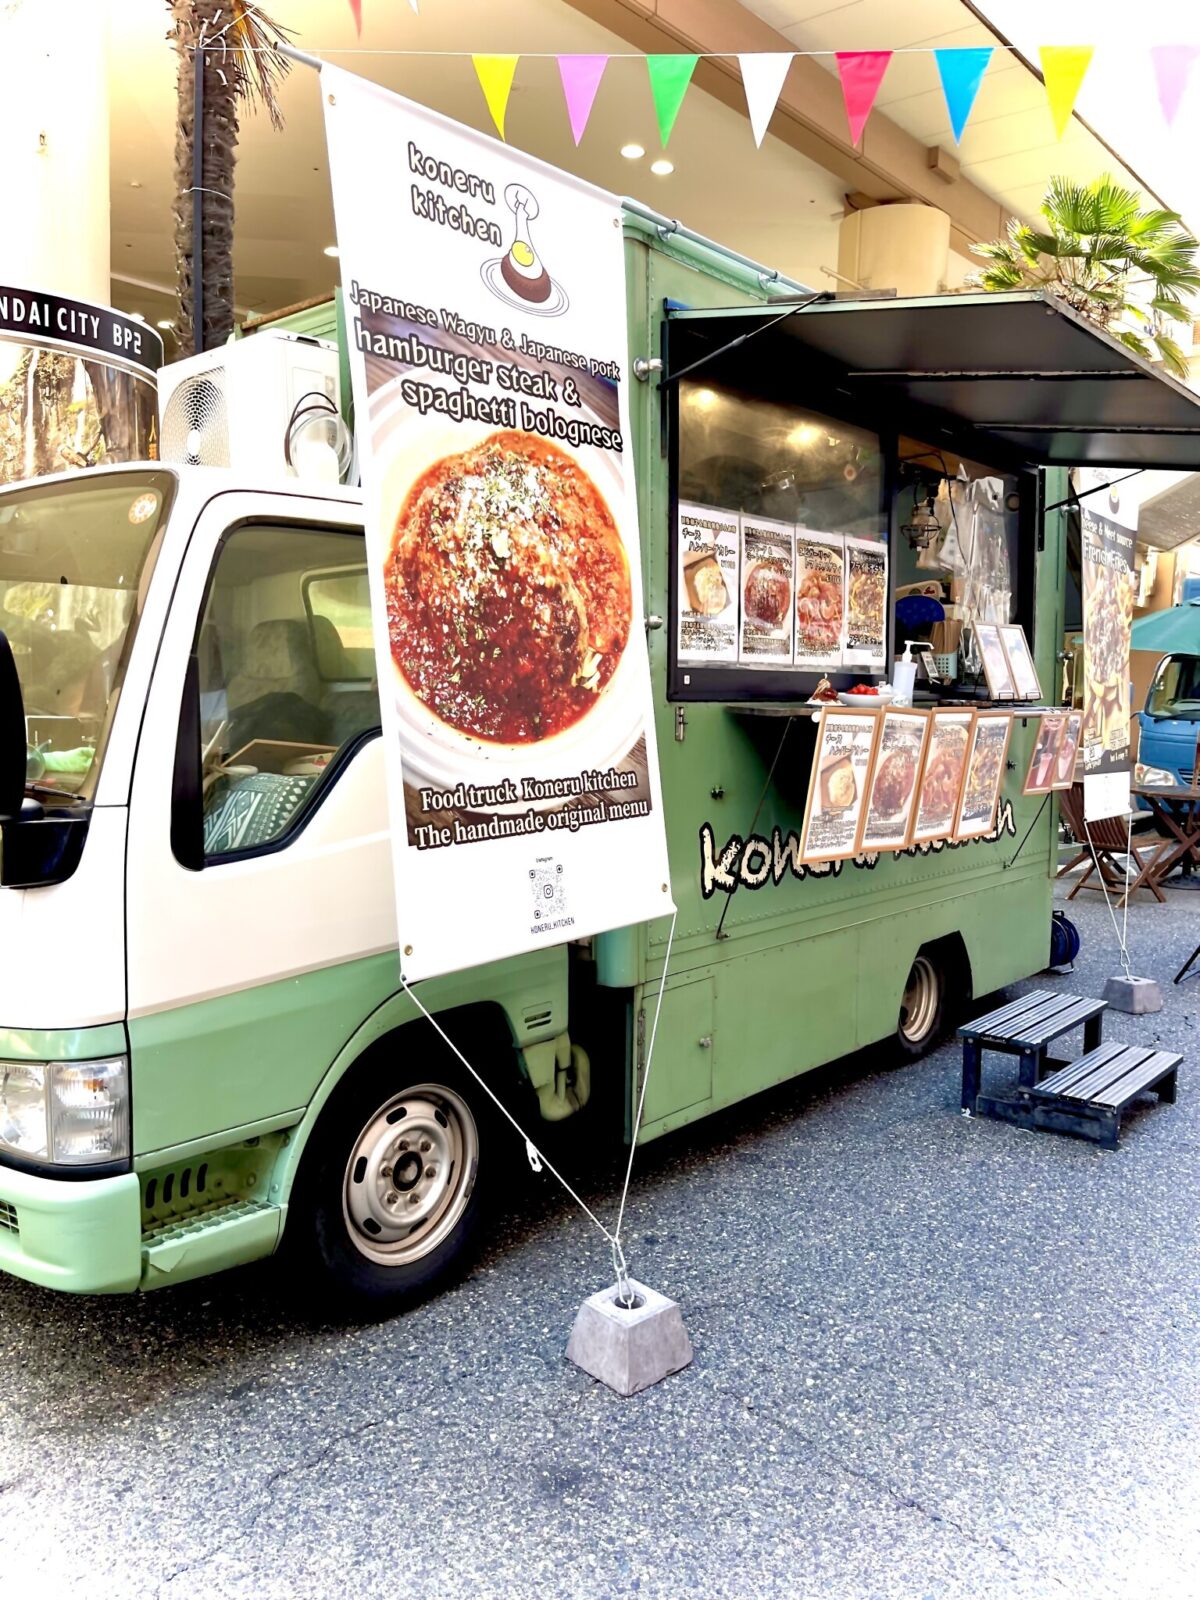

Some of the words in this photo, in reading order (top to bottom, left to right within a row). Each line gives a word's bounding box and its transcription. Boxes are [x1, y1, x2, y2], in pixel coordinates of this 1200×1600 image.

[408, 141, 495, 204] koneru
[411, 184, 502, 247] kitchen
[57, 307, 100, 339] CITY
[113, 323, 142, 355] BP2
[350, 280, 438, 328] Japanese
[440, 309, 497, 346] Wagyu
[501, 328, 515, 350] &
[520, 335, 588, 372] Japanese
[590, 358, 621, 382] pork
[354, 319, 493, 384] hamburger
[496, 361, 558, 404] steak
[563, 379, 581, 407] &
[401, 378, 516, 428] spaghetti
[522, 404, 624, 452] bolognese
[420, 785, 466, 812] Food
[468, 778, 518, 806] truck
[521, 775, 582, 800] Koneru
[581, 766, 639, 792] kitchen
[414, 822, 453, 850] The
[453, 808, 546, 844] handmade
[546, 801, 606, 835] original
[606, 797, 651, 821] menu
